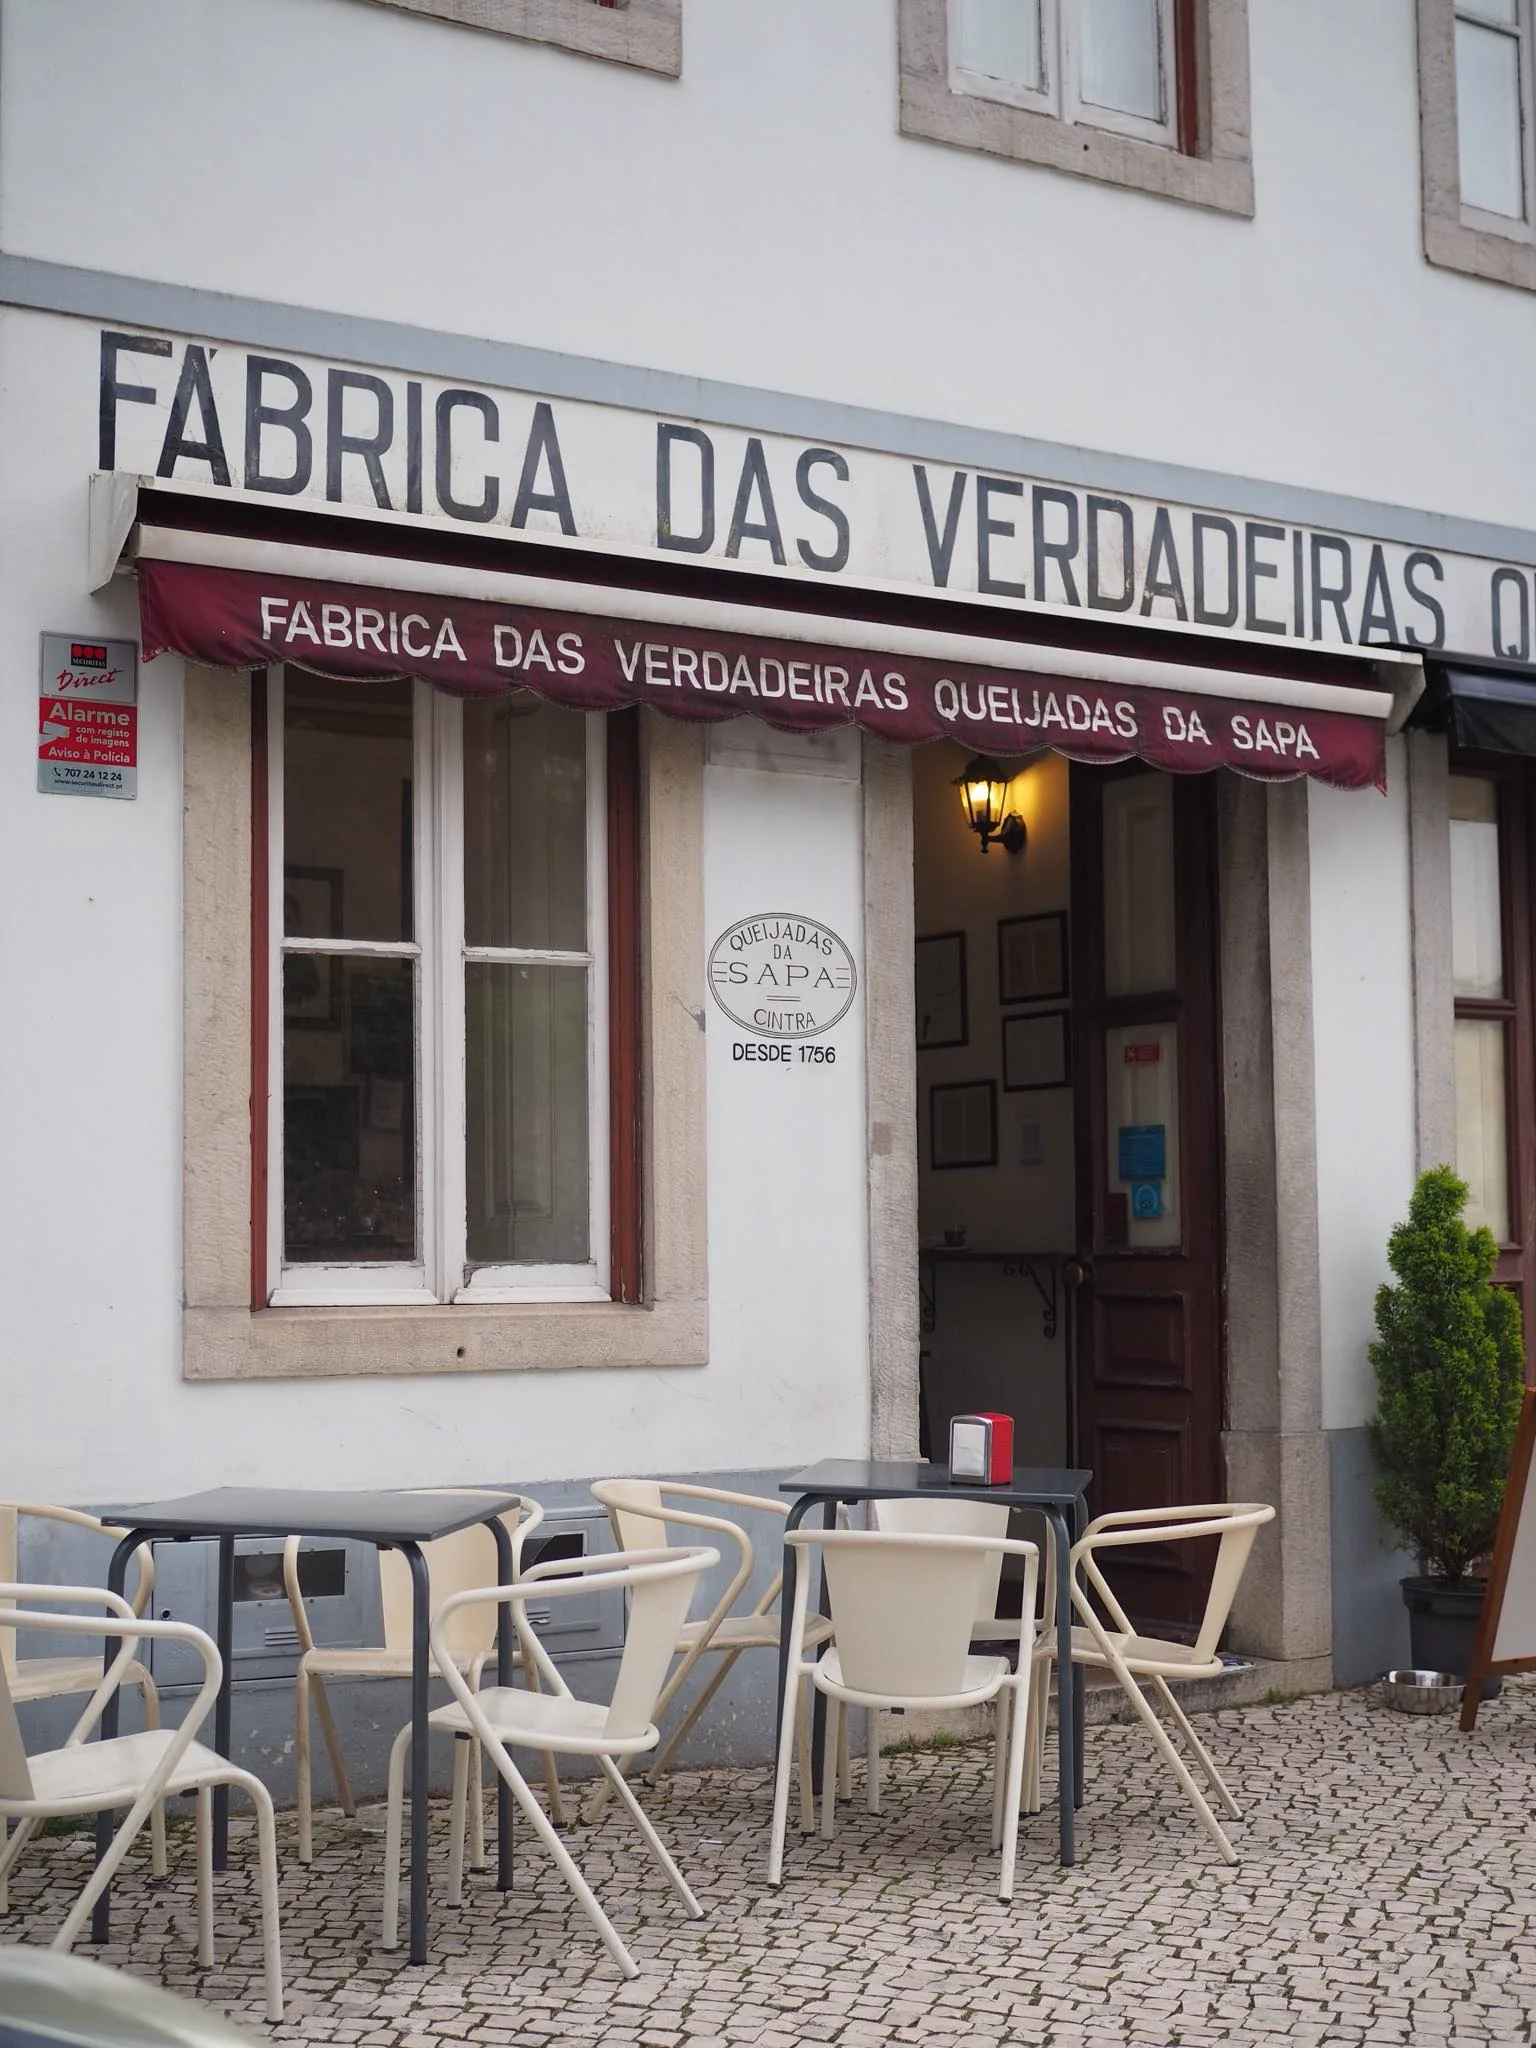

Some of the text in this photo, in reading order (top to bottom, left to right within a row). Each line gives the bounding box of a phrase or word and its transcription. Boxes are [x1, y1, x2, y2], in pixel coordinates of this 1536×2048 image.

[100, 330, 1536, 662] FÁBRICA DAS VERDADEIRAS Q
[72, 657, 106, 667] SECURITAS
[56, 668, 128, 691] Direct
[494, 624, 585, 674] DAS
[614, 639, 909, 710] VERDADEIRAS
[934, 678, 1139, 738] QUEIJADAS
[1162, 706, 1212, 745] DA
[1230, 715, 1320, 759] SAPA
[49, 702, 130, 726] Alarme
[76, 726, 130, 739] com registo
[76, 735, 129, 748] de imagens
[48, 746, 80, 759] Aviso
[83, 749, 90, 760] à
[54, 779, 123, 790] www.securitasdirect.pt
[64, 768, 122, 782] 707 24 12 24
[730, 921, 833, 955] QUEIJADAS
[773, 944, 792, 960] DA
[729, 962, 835, 988] SAPA
[753, 1008, 816, 1031] CINTRA
[732, 1043, 836, 1064] DESDE 1756
